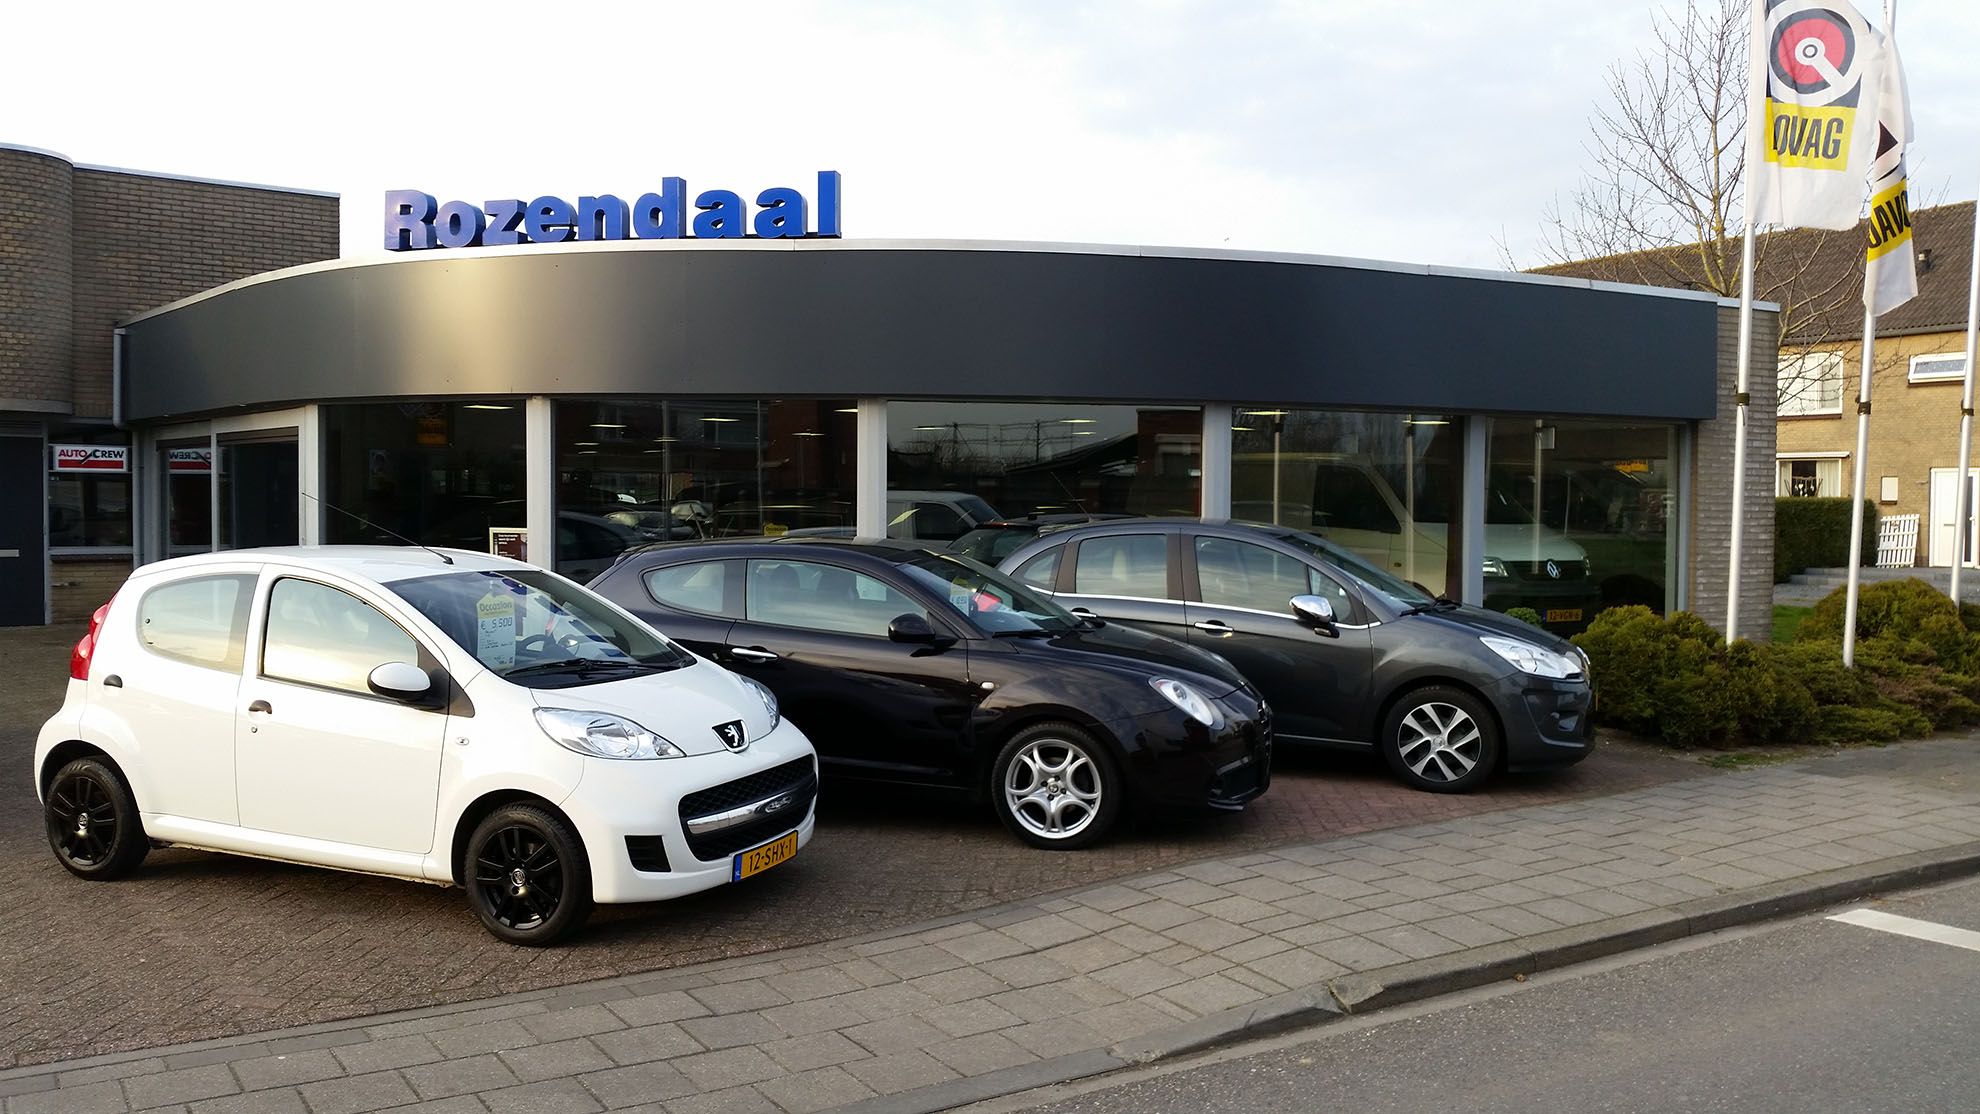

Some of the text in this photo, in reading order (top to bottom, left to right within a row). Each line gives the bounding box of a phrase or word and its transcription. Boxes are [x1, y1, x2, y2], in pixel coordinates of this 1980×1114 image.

[1773, 114, 1844, 159] OVAG
[384, 170, 842, 252] Rozendaal
[58, 449, 124, 458] AUTO CREW
[749, 838, 792, 873] 12-SHX-1
